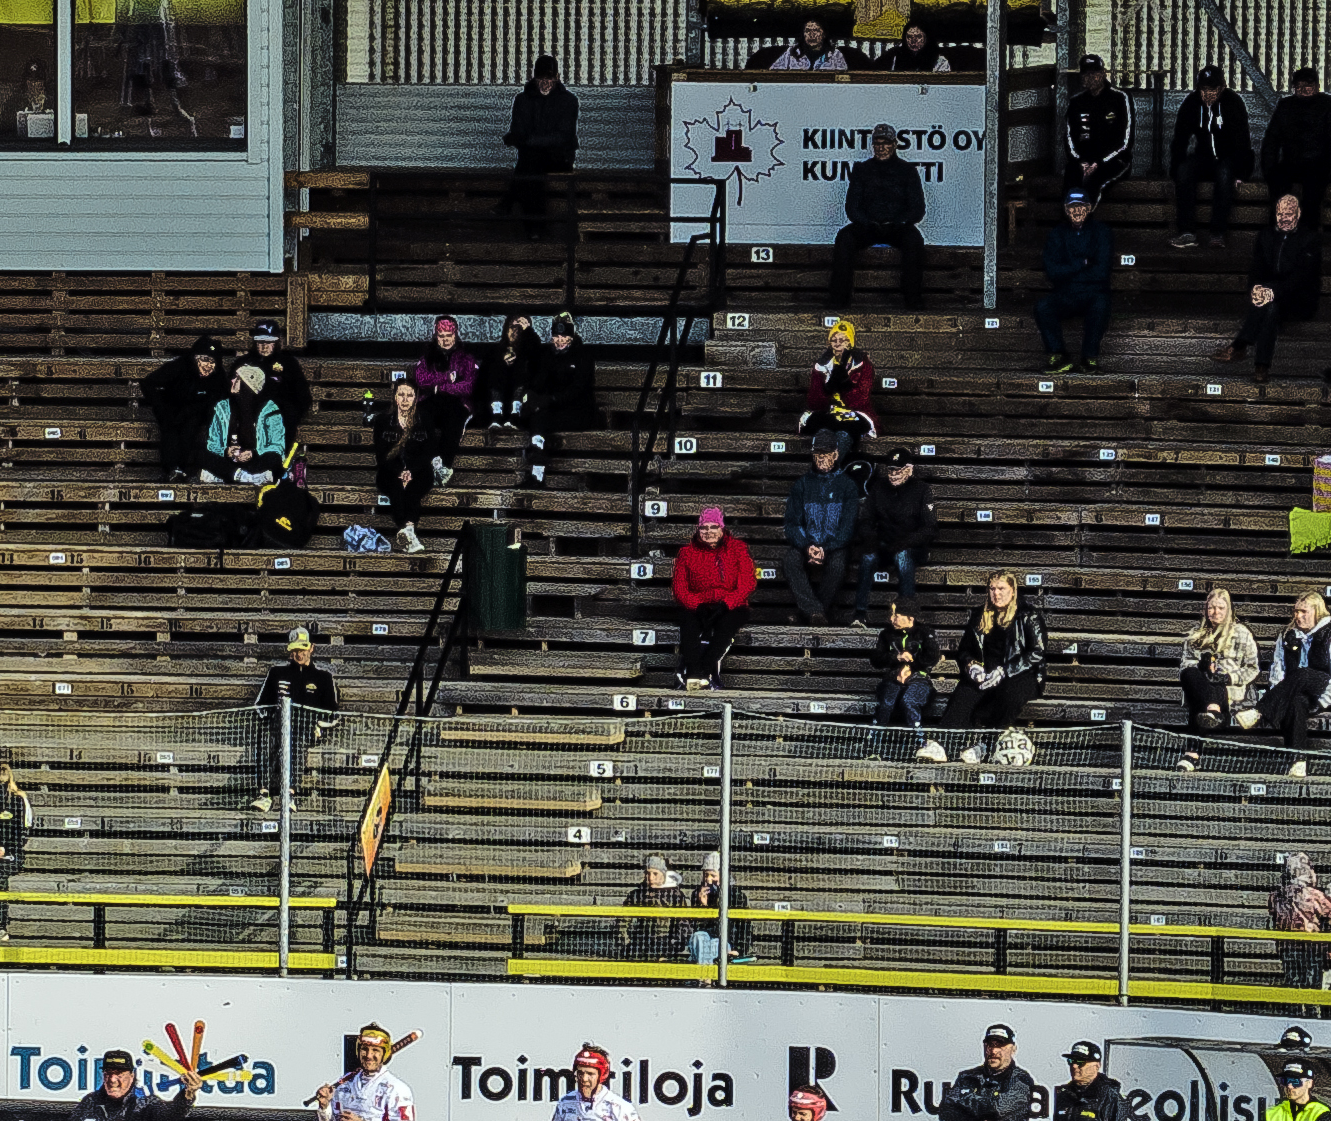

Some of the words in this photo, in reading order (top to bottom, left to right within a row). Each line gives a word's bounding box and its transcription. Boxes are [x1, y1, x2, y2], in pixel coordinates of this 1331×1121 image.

[802, 124, 947, 151] KIINTSTÖ
[753, 249, 772, 261] 13
[729, 315, 747, 327] 12
[703, 374, 719, 386] 11
[676, 440, 694, 451] 10
[650, 503, 661, 515] 9
[636, 565, 647, 577] 8
[639, 631, 649, 644] 7
[620, 696, 630, 709] 6
[596, 764, 606, 776] 5
[573, 829, 583, 841] 4
[451, 1054, 734, 1118] Toimiloja
